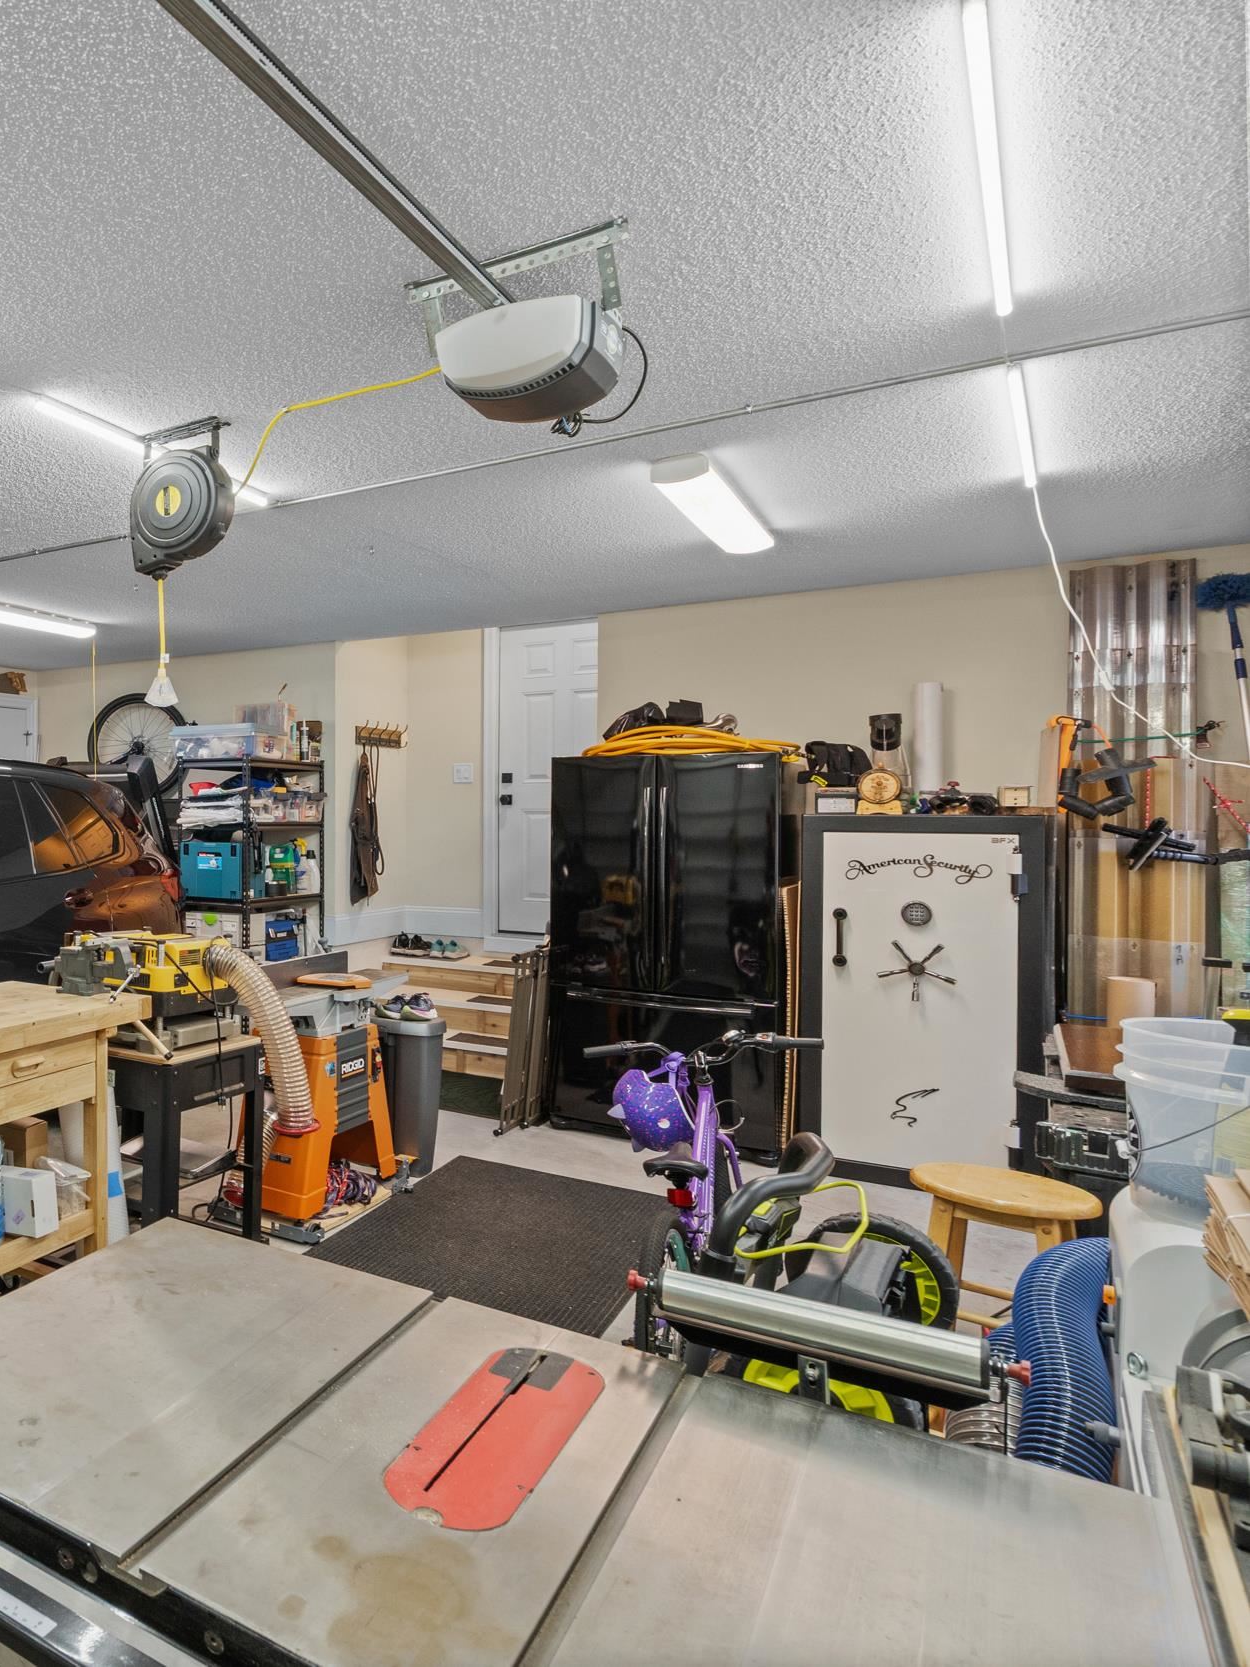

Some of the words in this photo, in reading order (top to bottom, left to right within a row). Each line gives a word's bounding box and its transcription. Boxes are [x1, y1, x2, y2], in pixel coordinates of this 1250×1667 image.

[845, 857, 922, 881] American
[913, 854, 993, 885] Security
[341, 1058, 365, 1075] RIDGID
